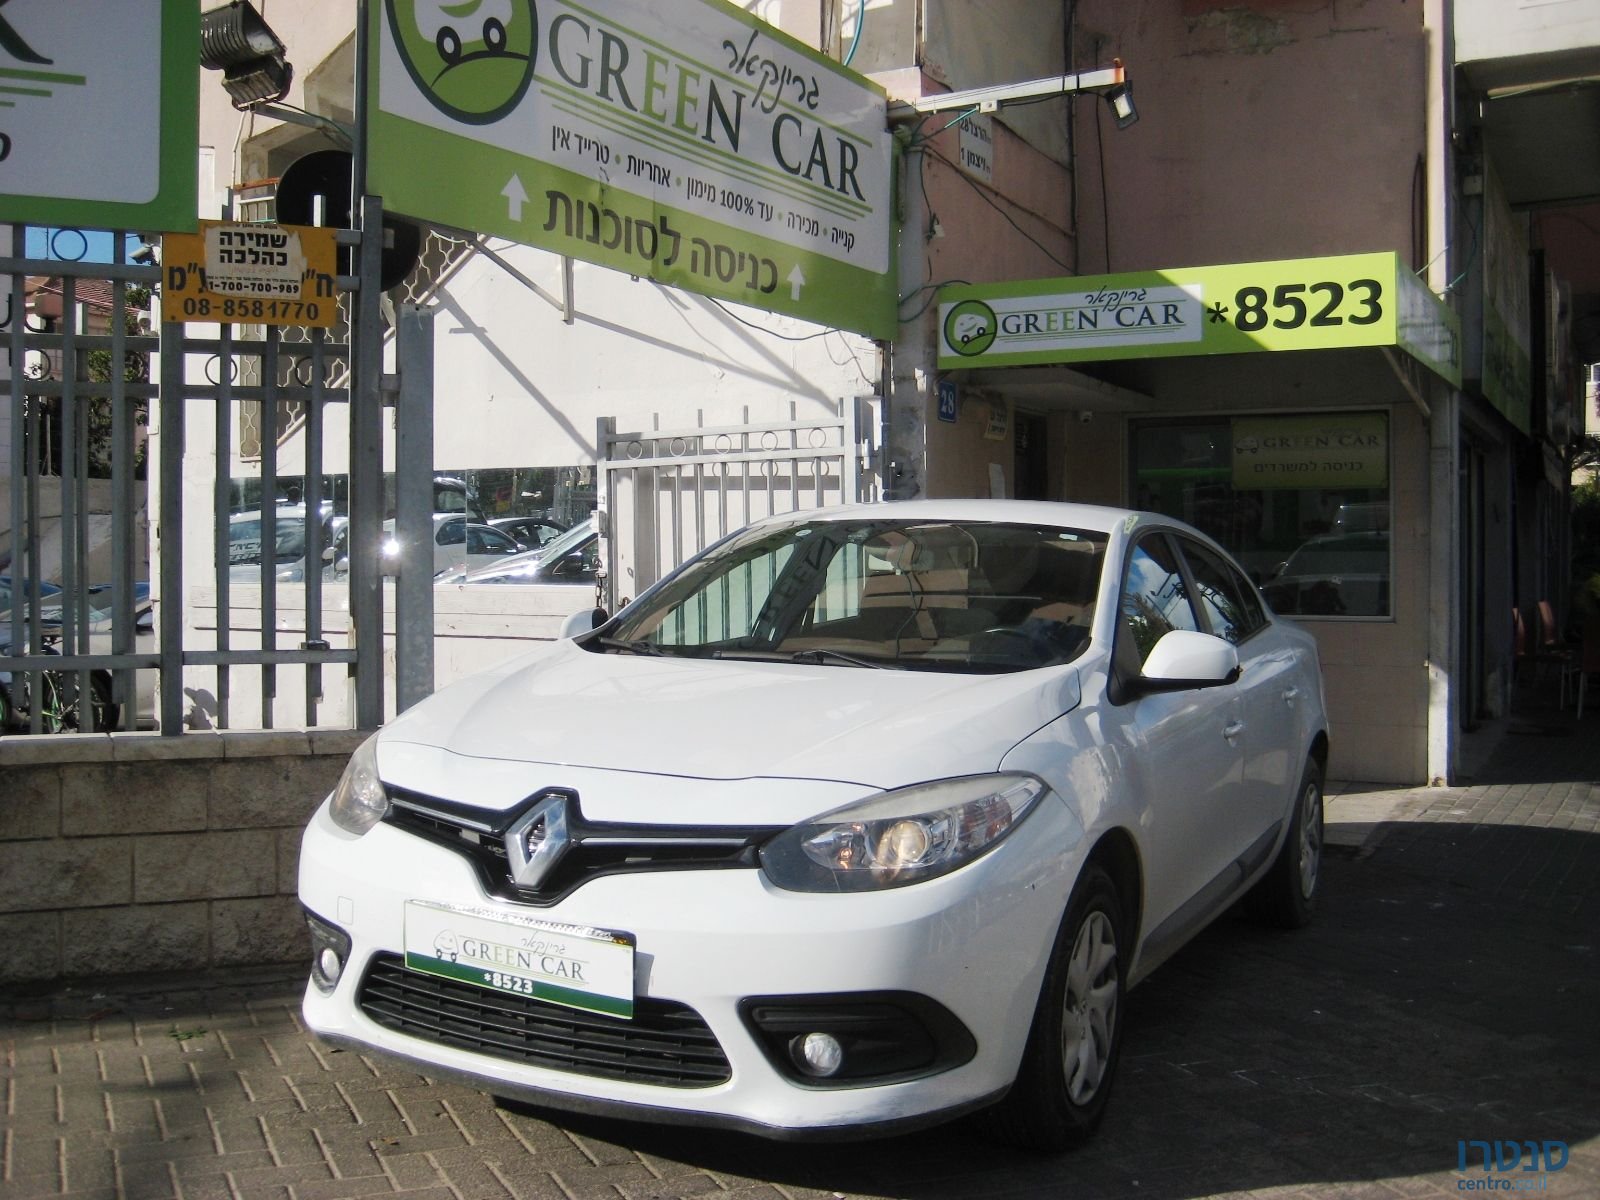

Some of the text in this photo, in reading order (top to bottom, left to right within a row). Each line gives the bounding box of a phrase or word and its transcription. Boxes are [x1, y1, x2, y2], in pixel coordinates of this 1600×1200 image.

[549, 13, 866, 201] GREEN CAR
[552, 125, 855, 252] קנייה מכירה עד 100% מימון אחריות טרייד אין
[219, 231, 287, 249] שמירה
[543, 190, 778, 294] כניסה לסוכנות
[219, 248, 288, 267] כהלכה
[208, 281, 300, 294] 1-700-700-989
[183, 297, 319, 321] 08-8581770
[1001, 309, 1098, 335] GREEN
[1115, 304, 1185, 327] CAR
[940, 389, 954, 415] 28
[1263, 434, 1380, 449] GREEN CAR
[1323, 461, 1363, 472] כניסה
[462, 939, 585, 981] GREEN CAR
